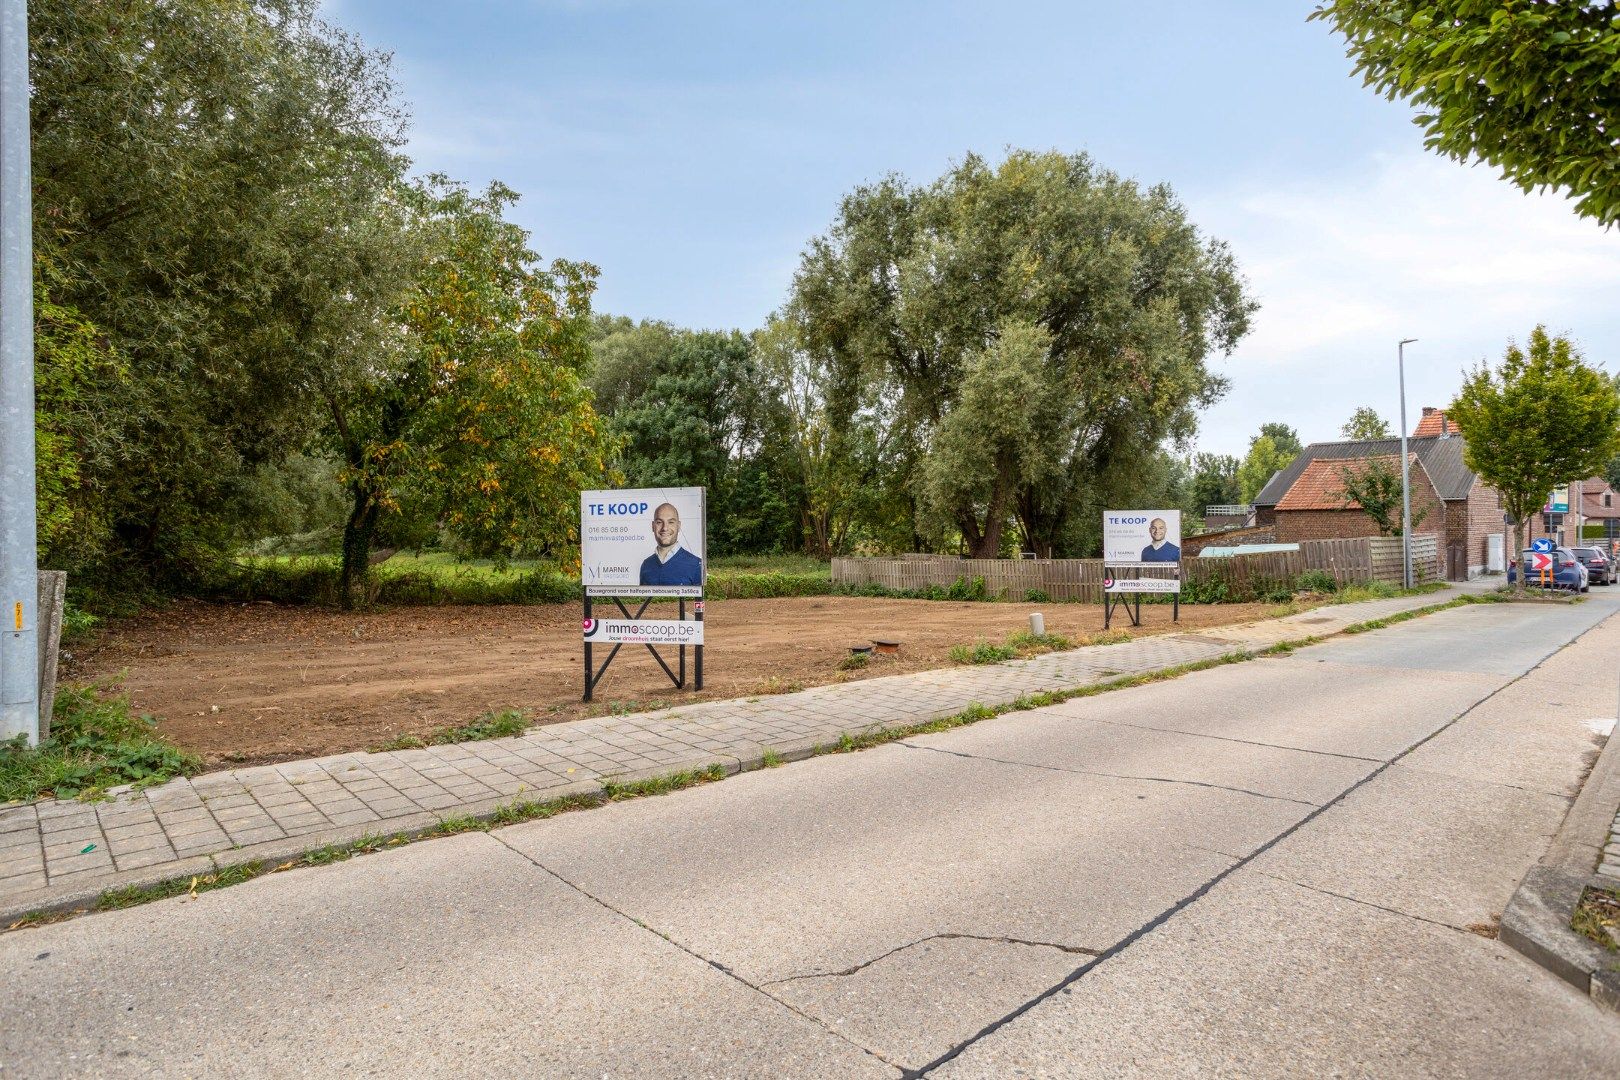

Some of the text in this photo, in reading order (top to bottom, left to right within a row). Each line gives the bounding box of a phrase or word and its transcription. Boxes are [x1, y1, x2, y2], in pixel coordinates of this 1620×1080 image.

[589, 502, 648, 515] TE KOOP
[1120, 580, 1174, 588] immoscoop.be
[606, 622, 694, 637] immoscoop.be
